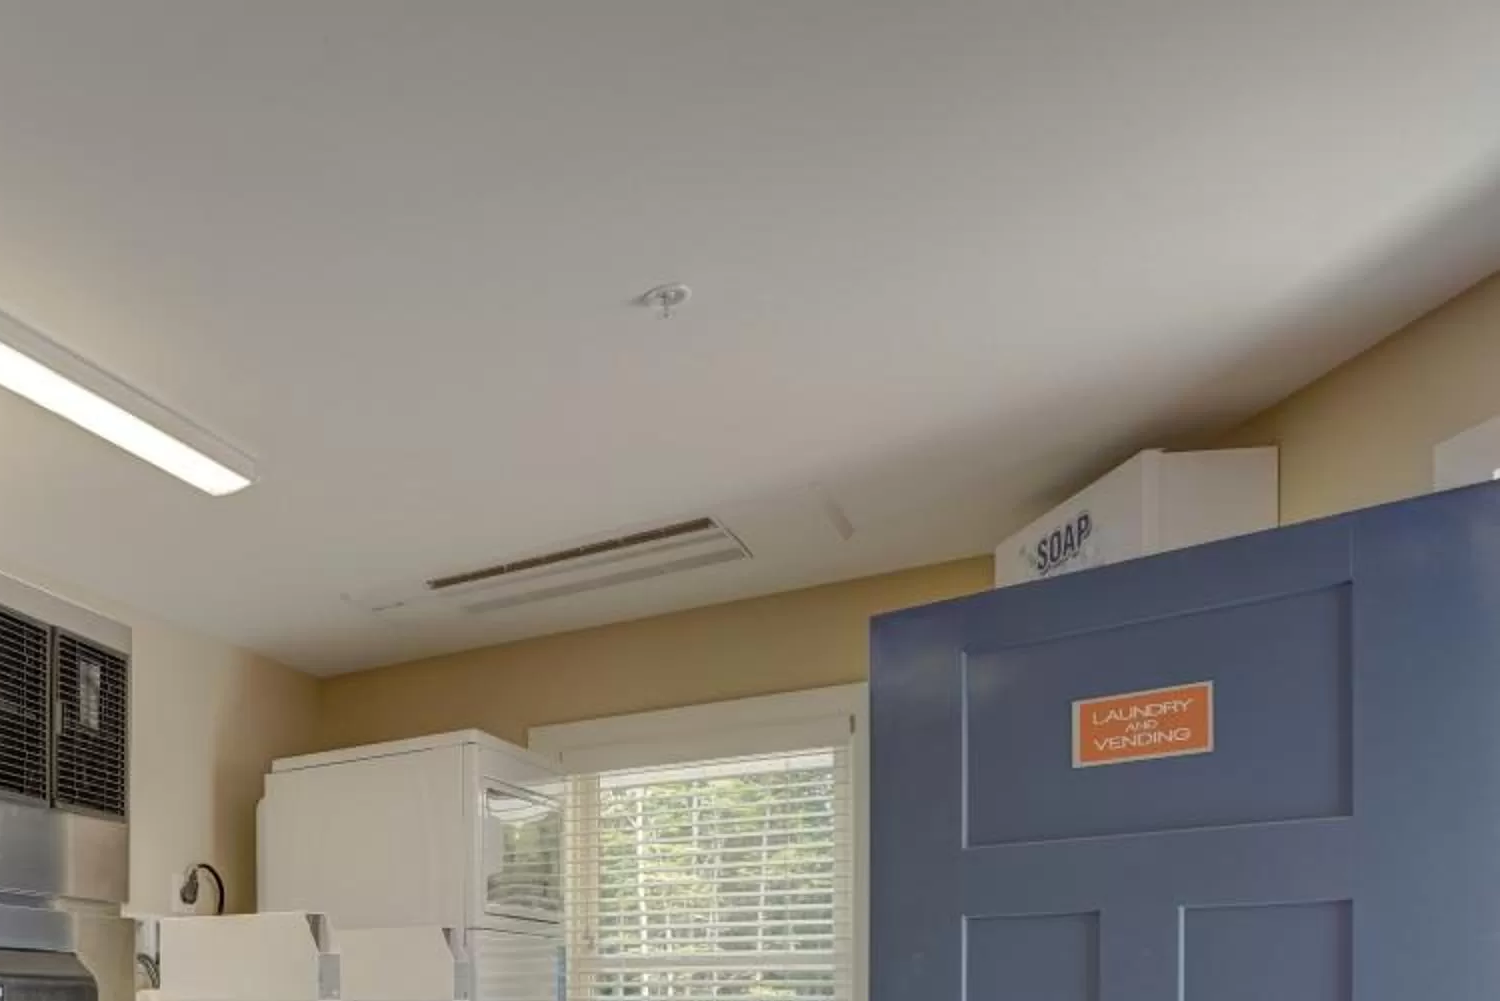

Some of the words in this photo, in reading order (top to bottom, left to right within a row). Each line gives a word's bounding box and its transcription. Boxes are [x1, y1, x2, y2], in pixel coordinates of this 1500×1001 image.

[1036, 512, 1092, 574] SOAP
[1092, 698, 1196, 726] LAUNDRY
[1093, 727, 1192, 751] VENDING
[1125, 719, 1159, 733] AND
